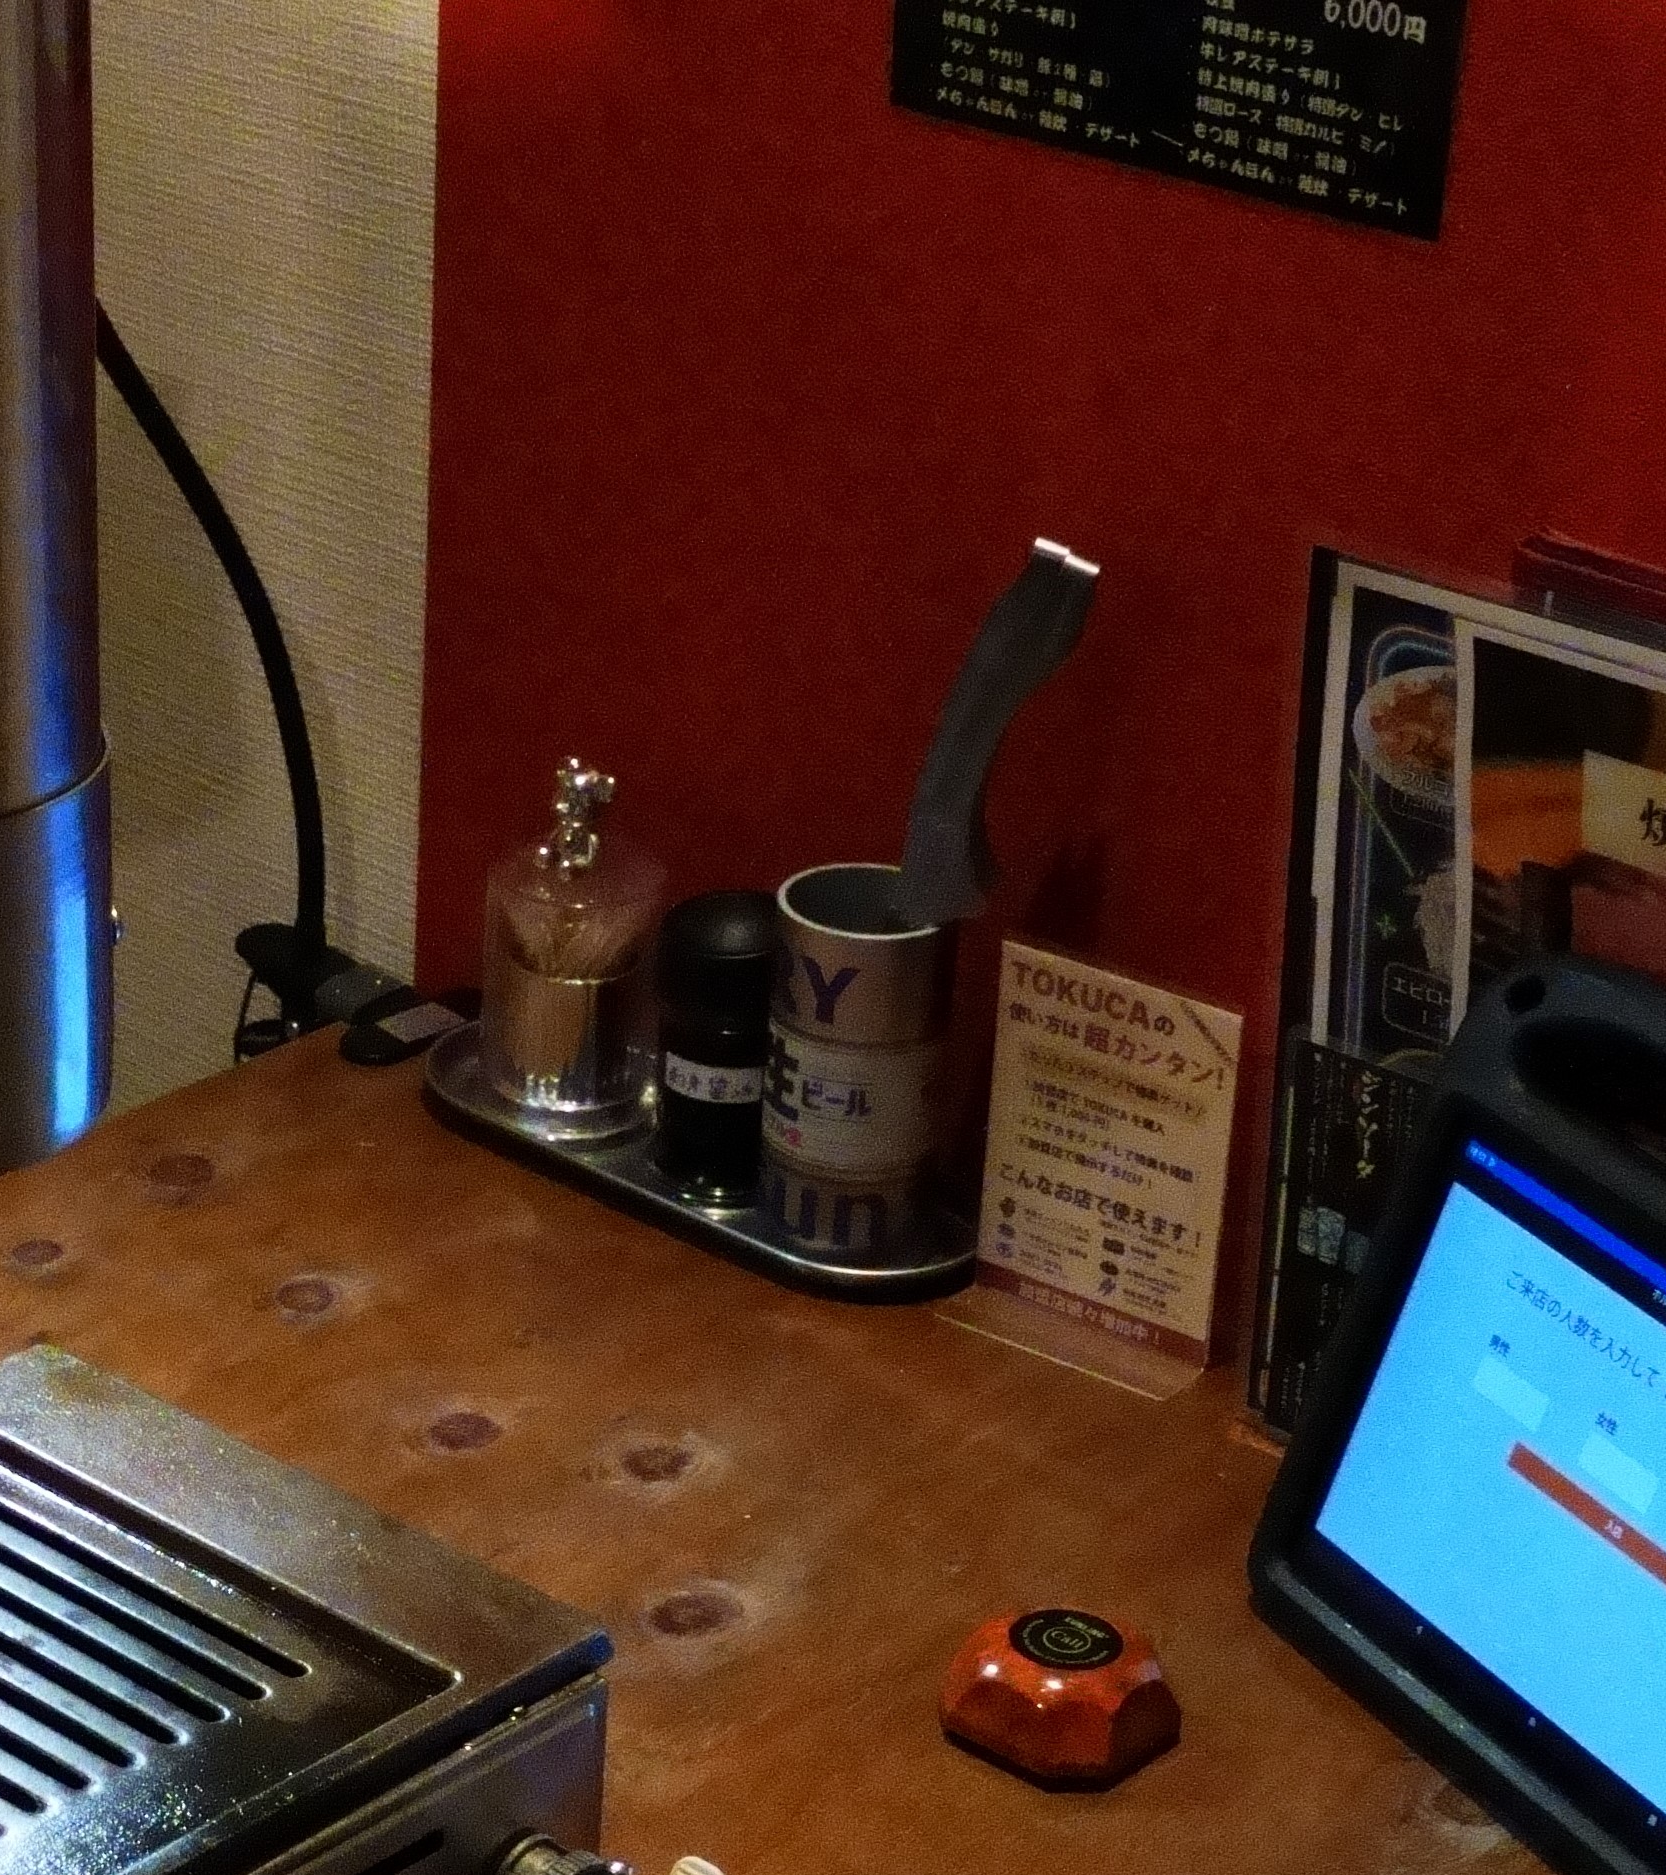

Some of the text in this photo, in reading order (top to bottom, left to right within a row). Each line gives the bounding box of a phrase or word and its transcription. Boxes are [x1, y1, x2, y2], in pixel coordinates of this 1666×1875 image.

[1011, 961, 1175, 1036] TOKUCAの
[1009, 1001, 1080, 1040] 使い方は
[1488, 1333, 1512, 1359] 男性
[1593, 1410, 1618, 1436] 女性
[1051, 1630, 1084, 1648] Call
